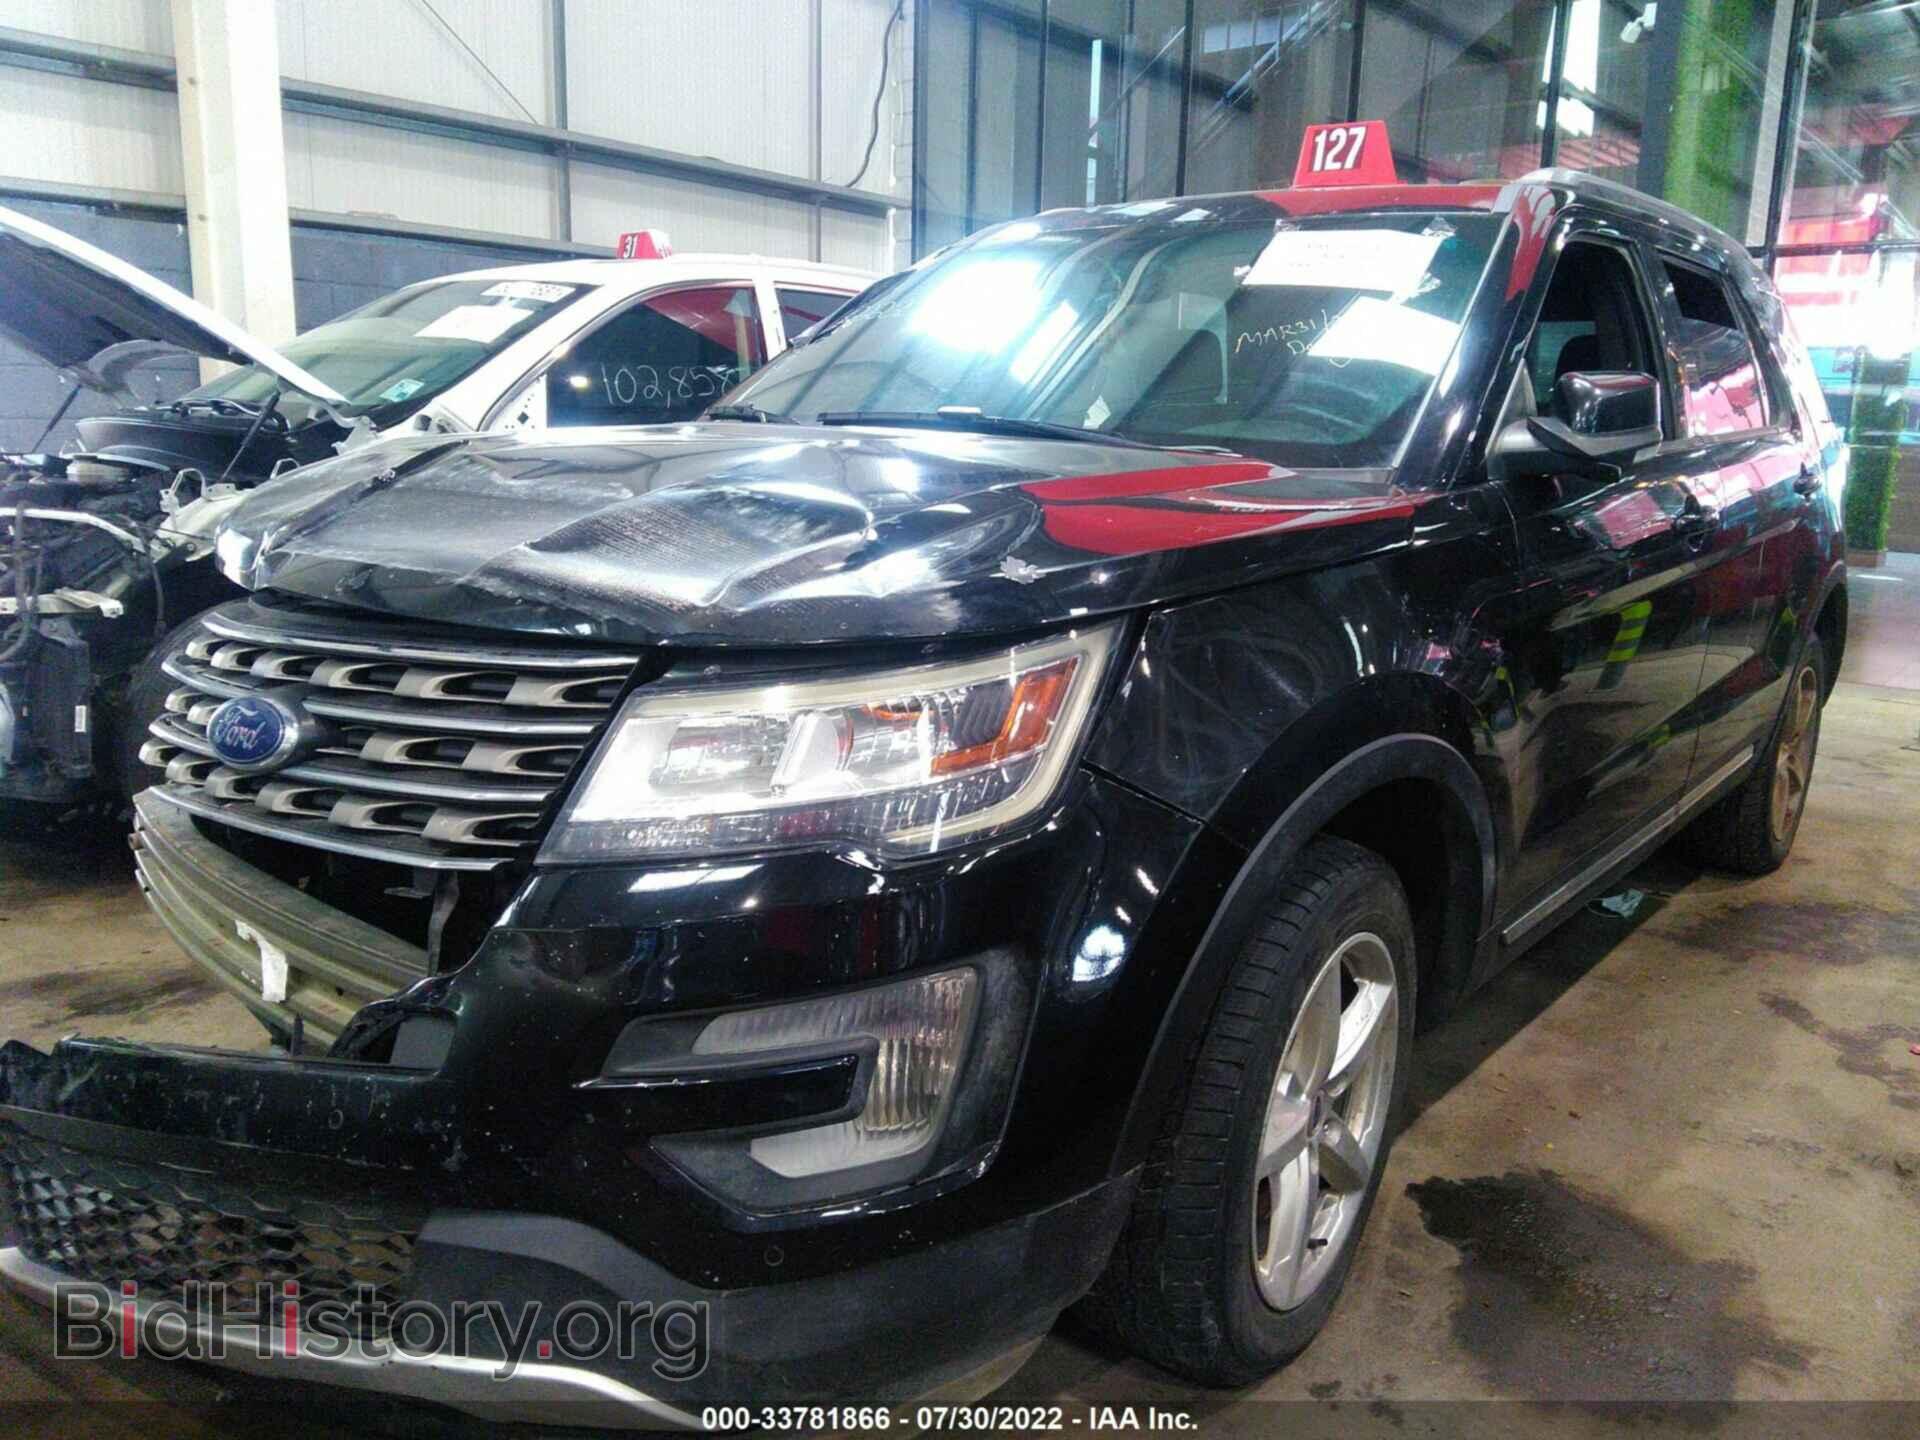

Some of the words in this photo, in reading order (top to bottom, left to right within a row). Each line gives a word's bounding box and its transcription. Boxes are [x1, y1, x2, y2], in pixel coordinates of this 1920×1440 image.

[1311, 126, 1367, 172] 127
[622, 234, 639, 259] 31
[214, 705, 266, 750] Ford
